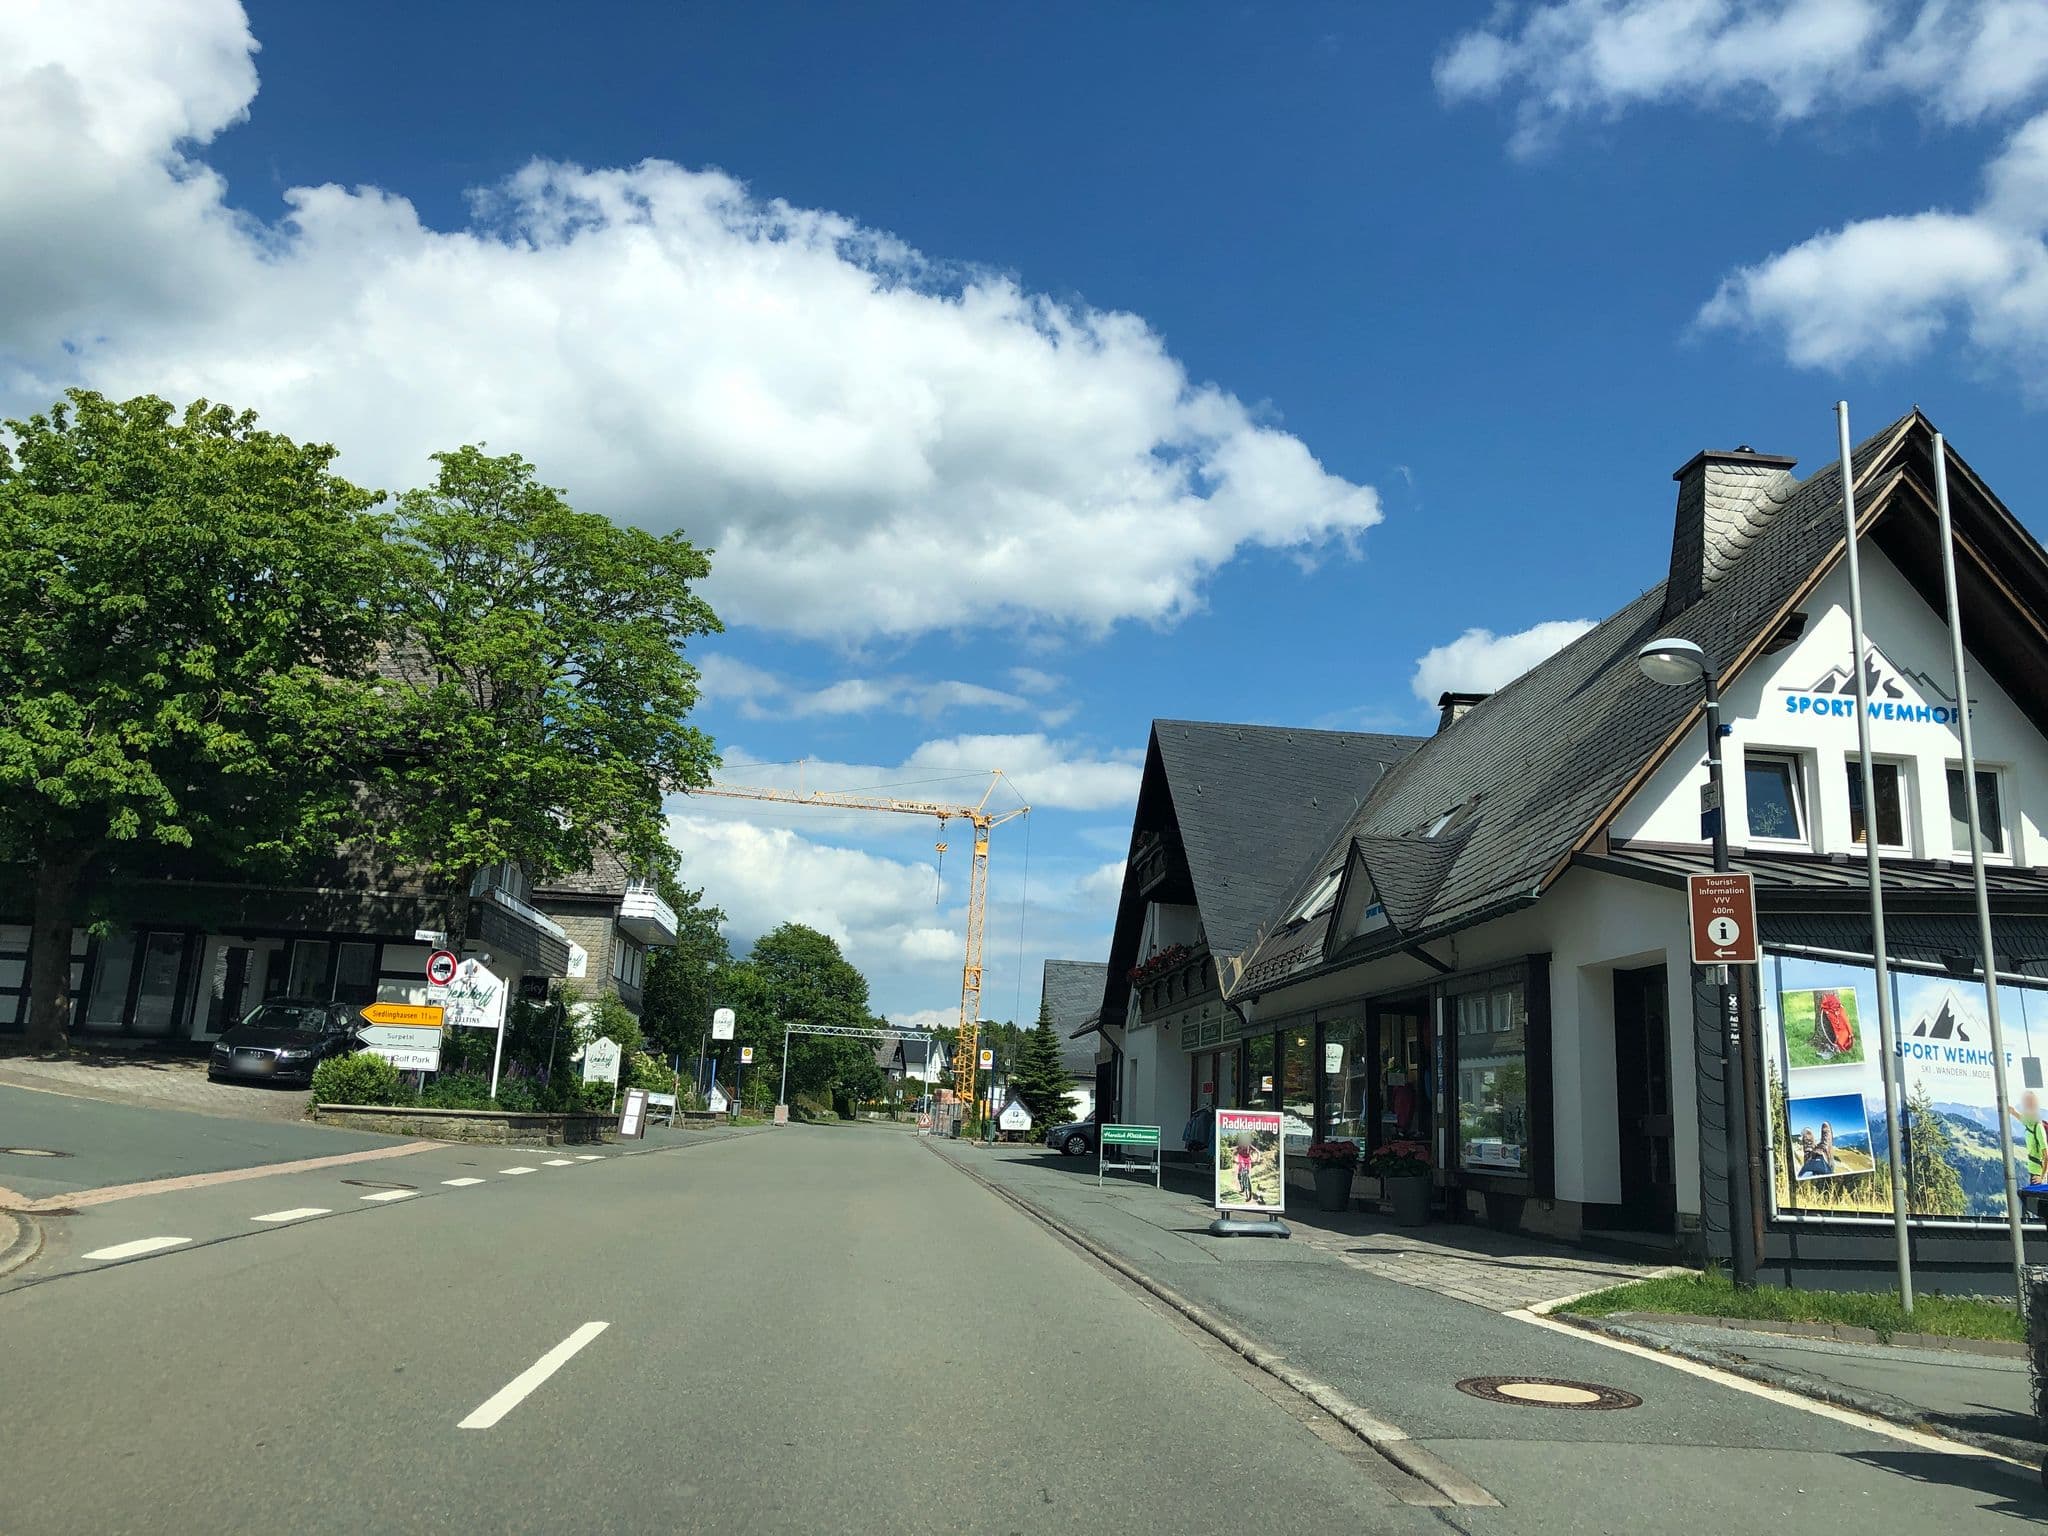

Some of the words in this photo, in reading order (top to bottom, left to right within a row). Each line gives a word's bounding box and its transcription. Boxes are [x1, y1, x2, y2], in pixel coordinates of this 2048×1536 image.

[1786, 696, 1854, 717] SPORT
[1867, 702, 1972, 724] WEMHOF
[1712, 907, 1734, 915] 400m
[524, 981, 545, 996] sky
[372, 1010, 418, 1020] Siedlinghausen
[1895, 1041, 1939, 1060] SPORT
[393, 1054, 409, 1063] Golf
[412, 1055, 431, 1064] Park
[1936, 1068, 1968, 1077] WANDERN
[1972, 1070, 1991, 1079] MODE
[1222, 1117, 1279, 1134] Radkleidung
